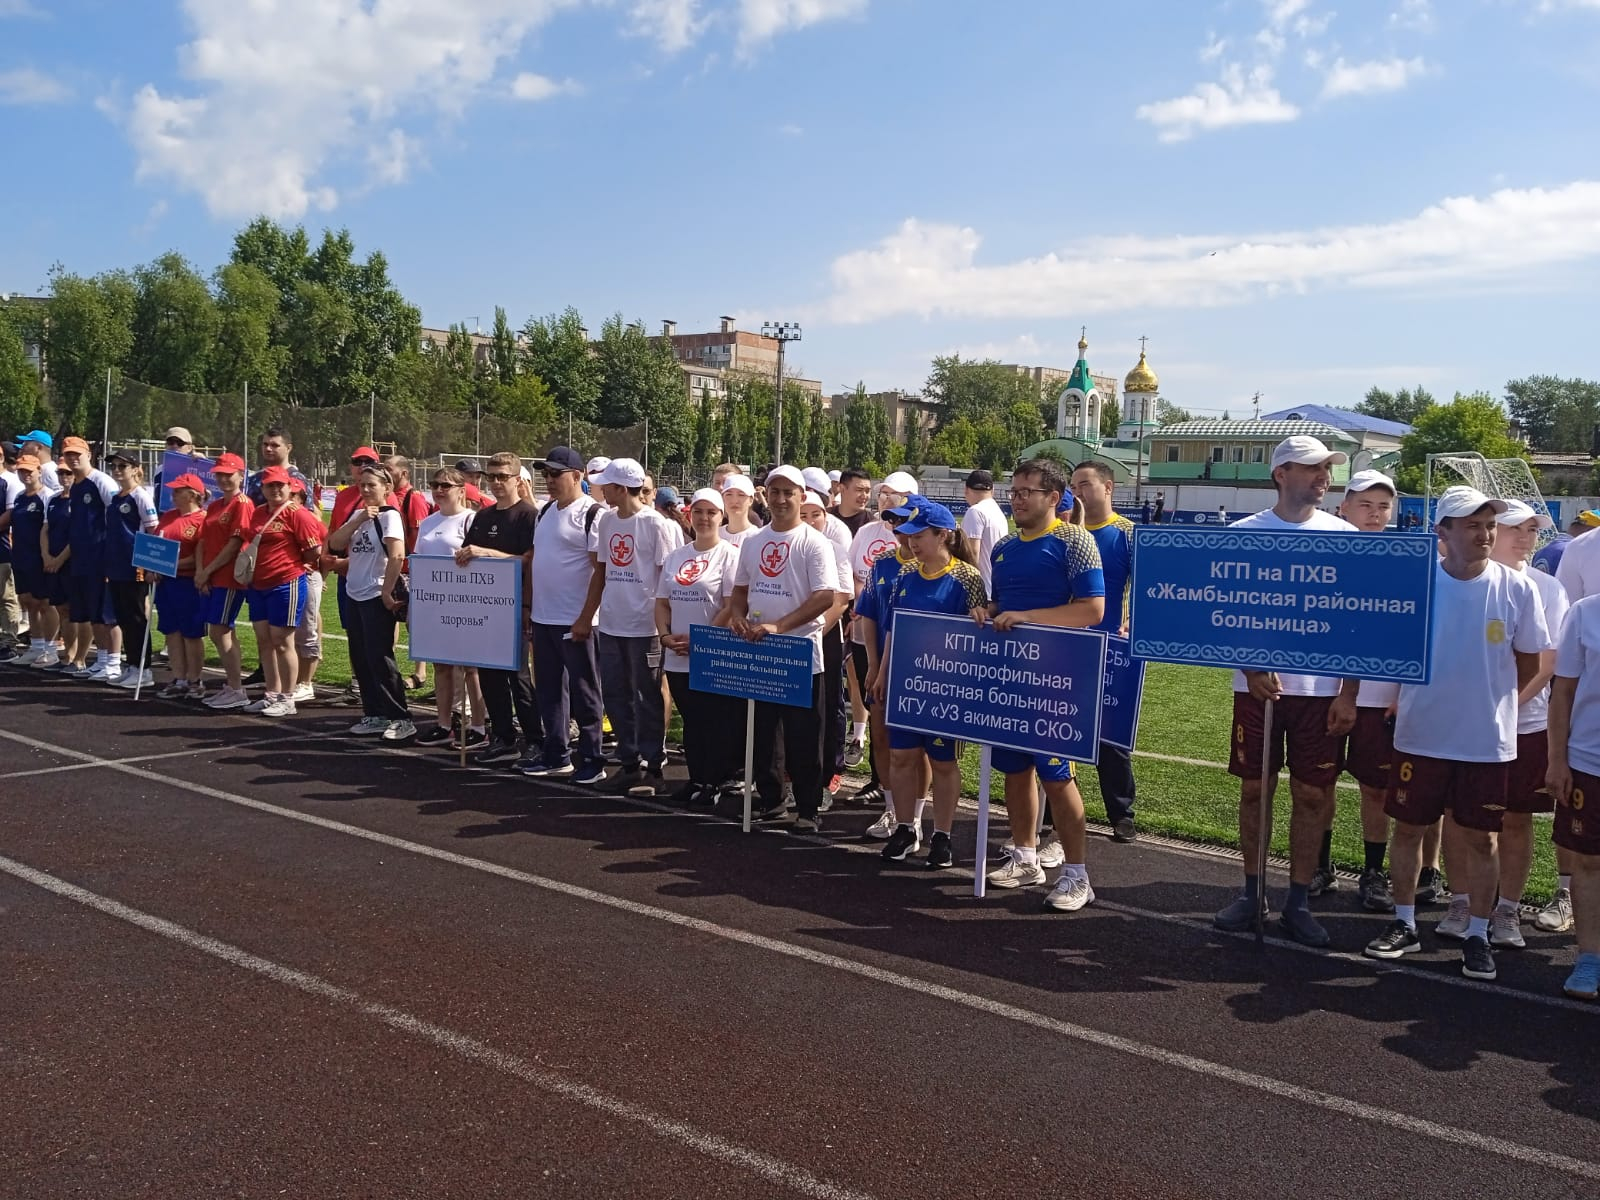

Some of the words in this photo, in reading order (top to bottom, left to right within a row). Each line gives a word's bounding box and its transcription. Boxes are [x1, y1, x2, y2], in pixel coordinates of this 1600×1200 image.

[431, 570, 453, 583] КГП
[456, 575, 467, 584] на
[469, 572, 495, 585] ПХВ
[1210, 561, 1250, 580] КГП
[1257, 567, 1282, 582] на
[1289, 564, 1338, 584] ПХВ
[411, 588, 446, 604] "Центр
[448, 593, 515, 607] психического
[1147, 583, 1297, 607] «Жамбылская
[1303, 592, 1416, 614] районная
[440, 615, 489, 628] здоровья"
[1211, 609, 1331, 635] больница»
[693, 643, 753, 660] Кызылжарская
[755, 652, 808, 667] центральная
[944, 632, 975, 652] КГП
[980, 641, 999, 656] на
[1004, 640, 1040, 661] ПХВ
[710, 659, 748, 671] районная
[749, 663, 788, 677] больница
[1105, 648, 1130, 668] СБ»
[914, 653, 1072, 691] «Многопрофильная
[904, 675, 983, 702] областная
[988, 687, 1079, 716] больница»
[898, 695, 927, 716] КГУ
[931, 702, 960, 721] «УЗ
[963, 710, 1029, 734] акимата
[1034, 718, 1083, 743] СКО»
[1237, 723, 1244, 743] 8
[1400, 761, 1413, 782] 6
[1572, 788, 1584, 810] 9
